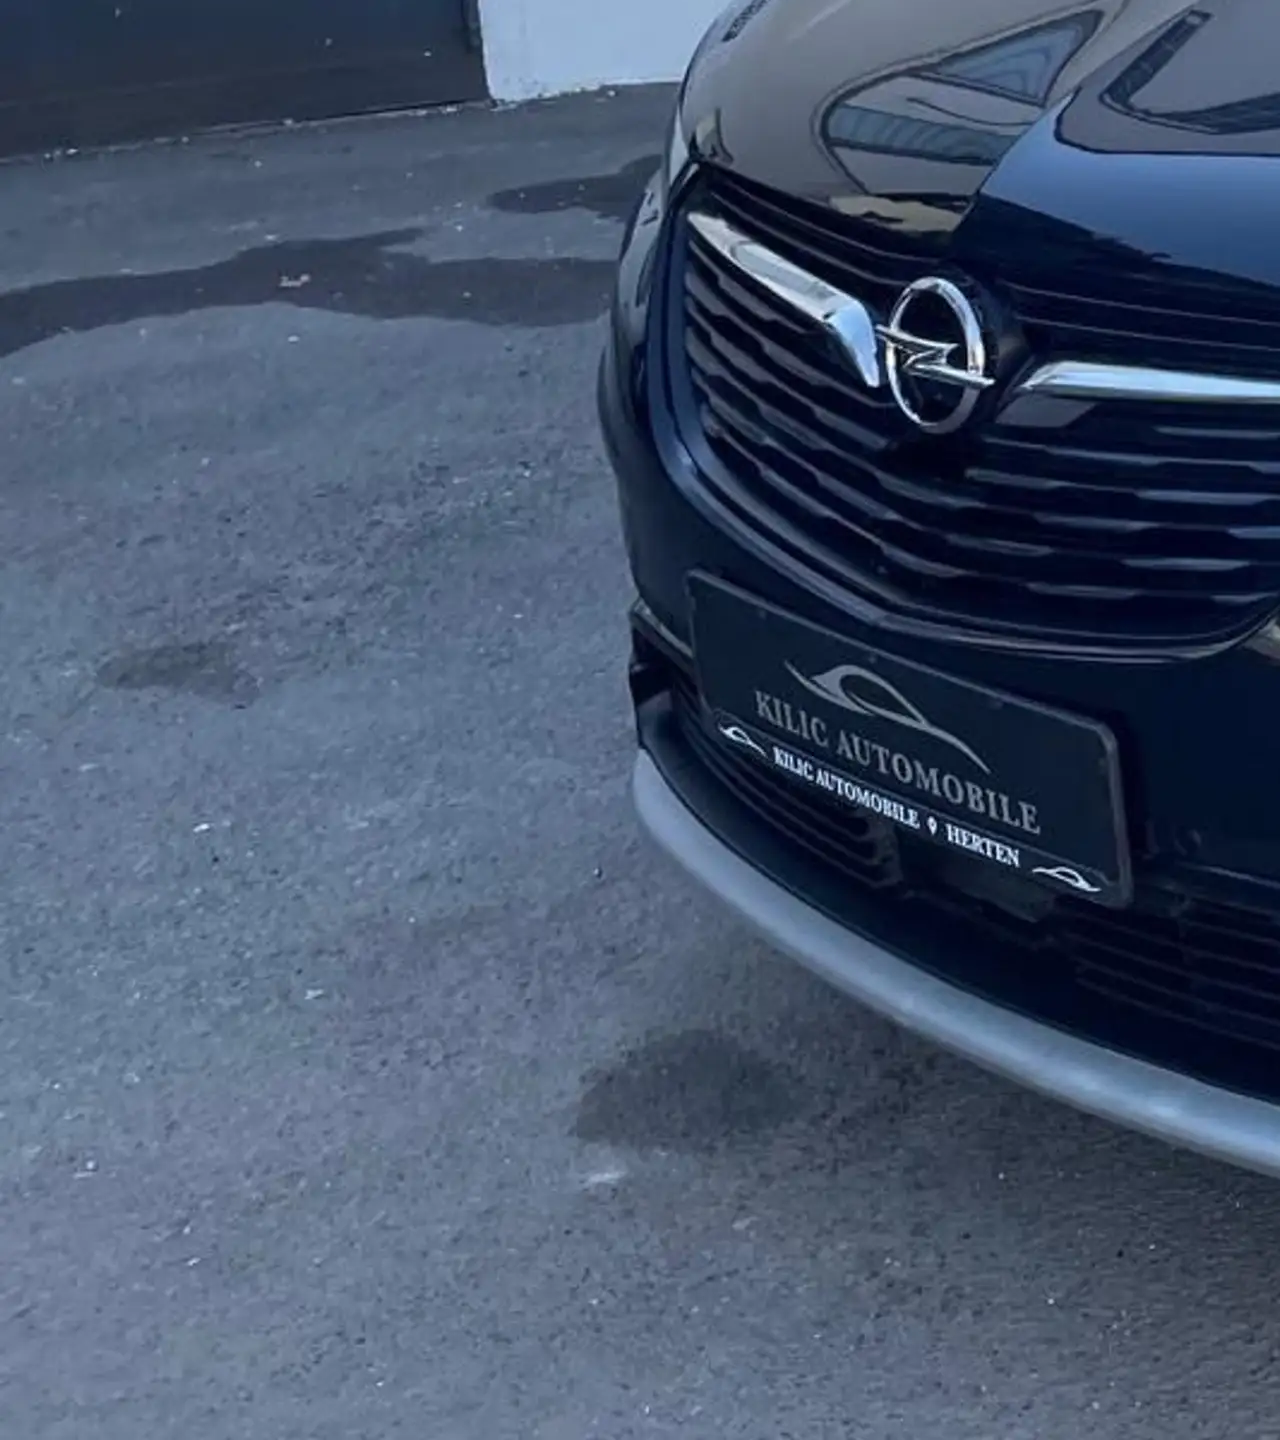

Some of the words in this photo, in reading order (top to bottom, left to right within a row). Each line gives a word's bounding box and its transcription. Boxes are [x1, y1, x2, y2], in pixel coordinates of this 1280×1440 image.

[755, 689, 829, 746] KILIC
[836, 731, 1041, 835] AUTOMOBILE
[772, 746, 814, 782] KILIC
[815, 768, 920, 830] AUTOMOBILE
[946, 822, 1019, 868] HERTEN
